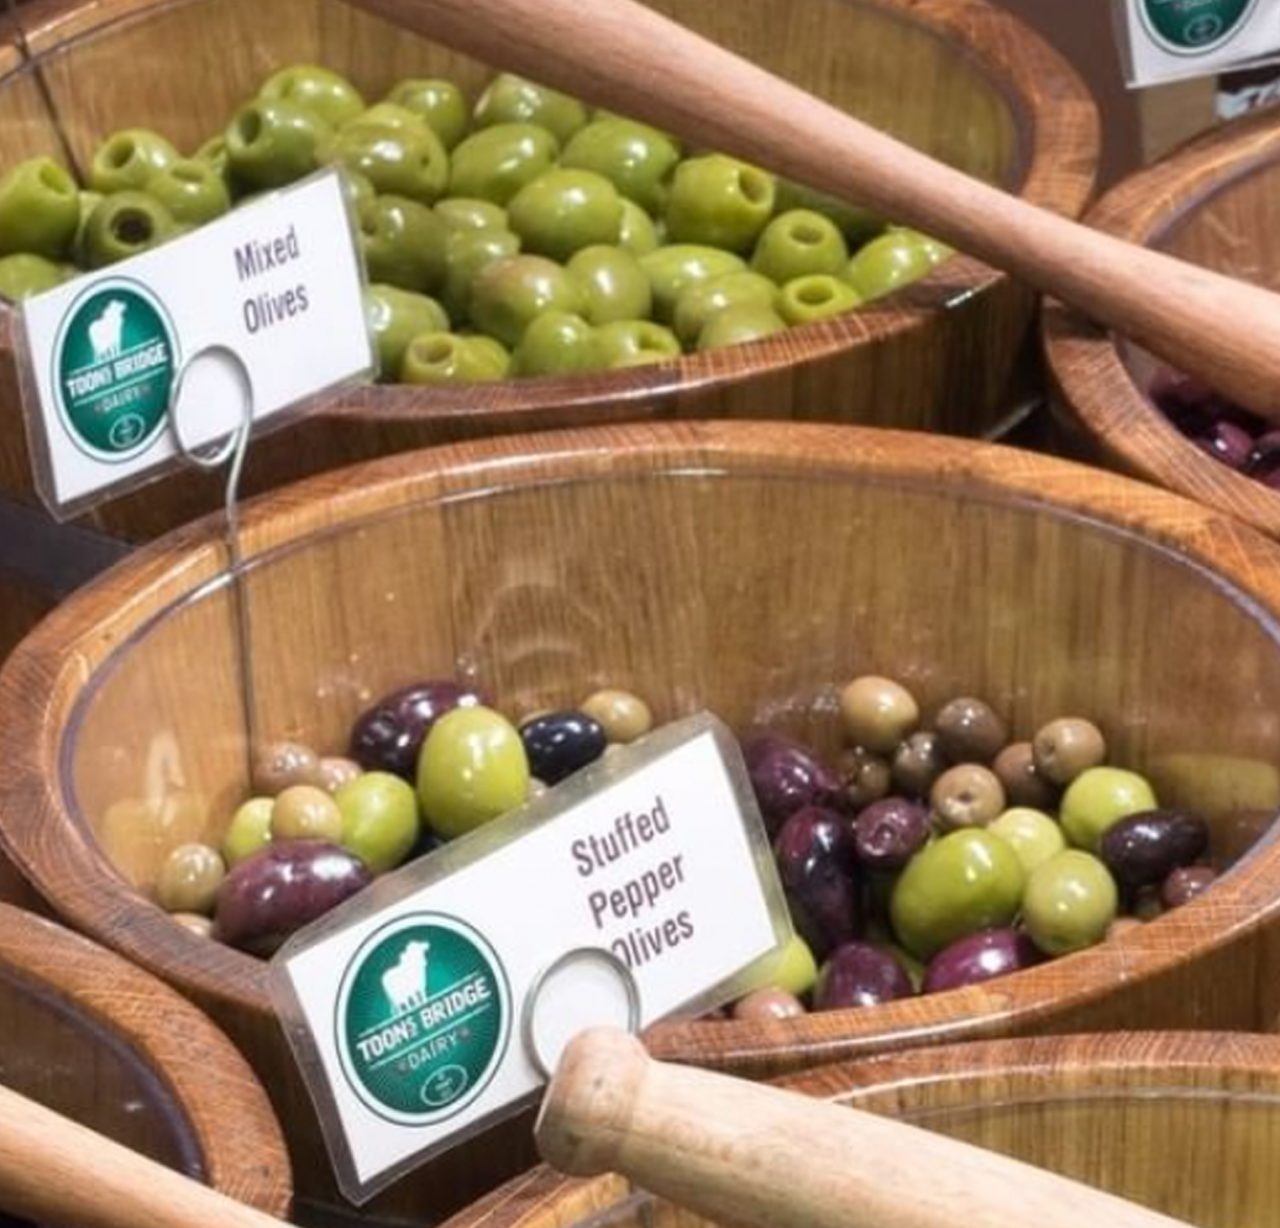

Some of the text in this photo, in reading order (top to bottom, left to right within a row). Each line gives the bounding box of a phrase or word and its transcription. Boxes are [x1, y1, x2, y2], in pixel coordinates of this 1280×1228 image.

[234, 222, 299, 282] Mixed
[243, 284, 309, 335] Olives
[114, 342, 168, 381] BRIDGE
[571, 795, 671, 877] Stuffed
[588, 855, 685, 930] Pepper
[420, 976, 492, 1030] BRIDGE
[408, 1031, 458, 1070] DAIRY
